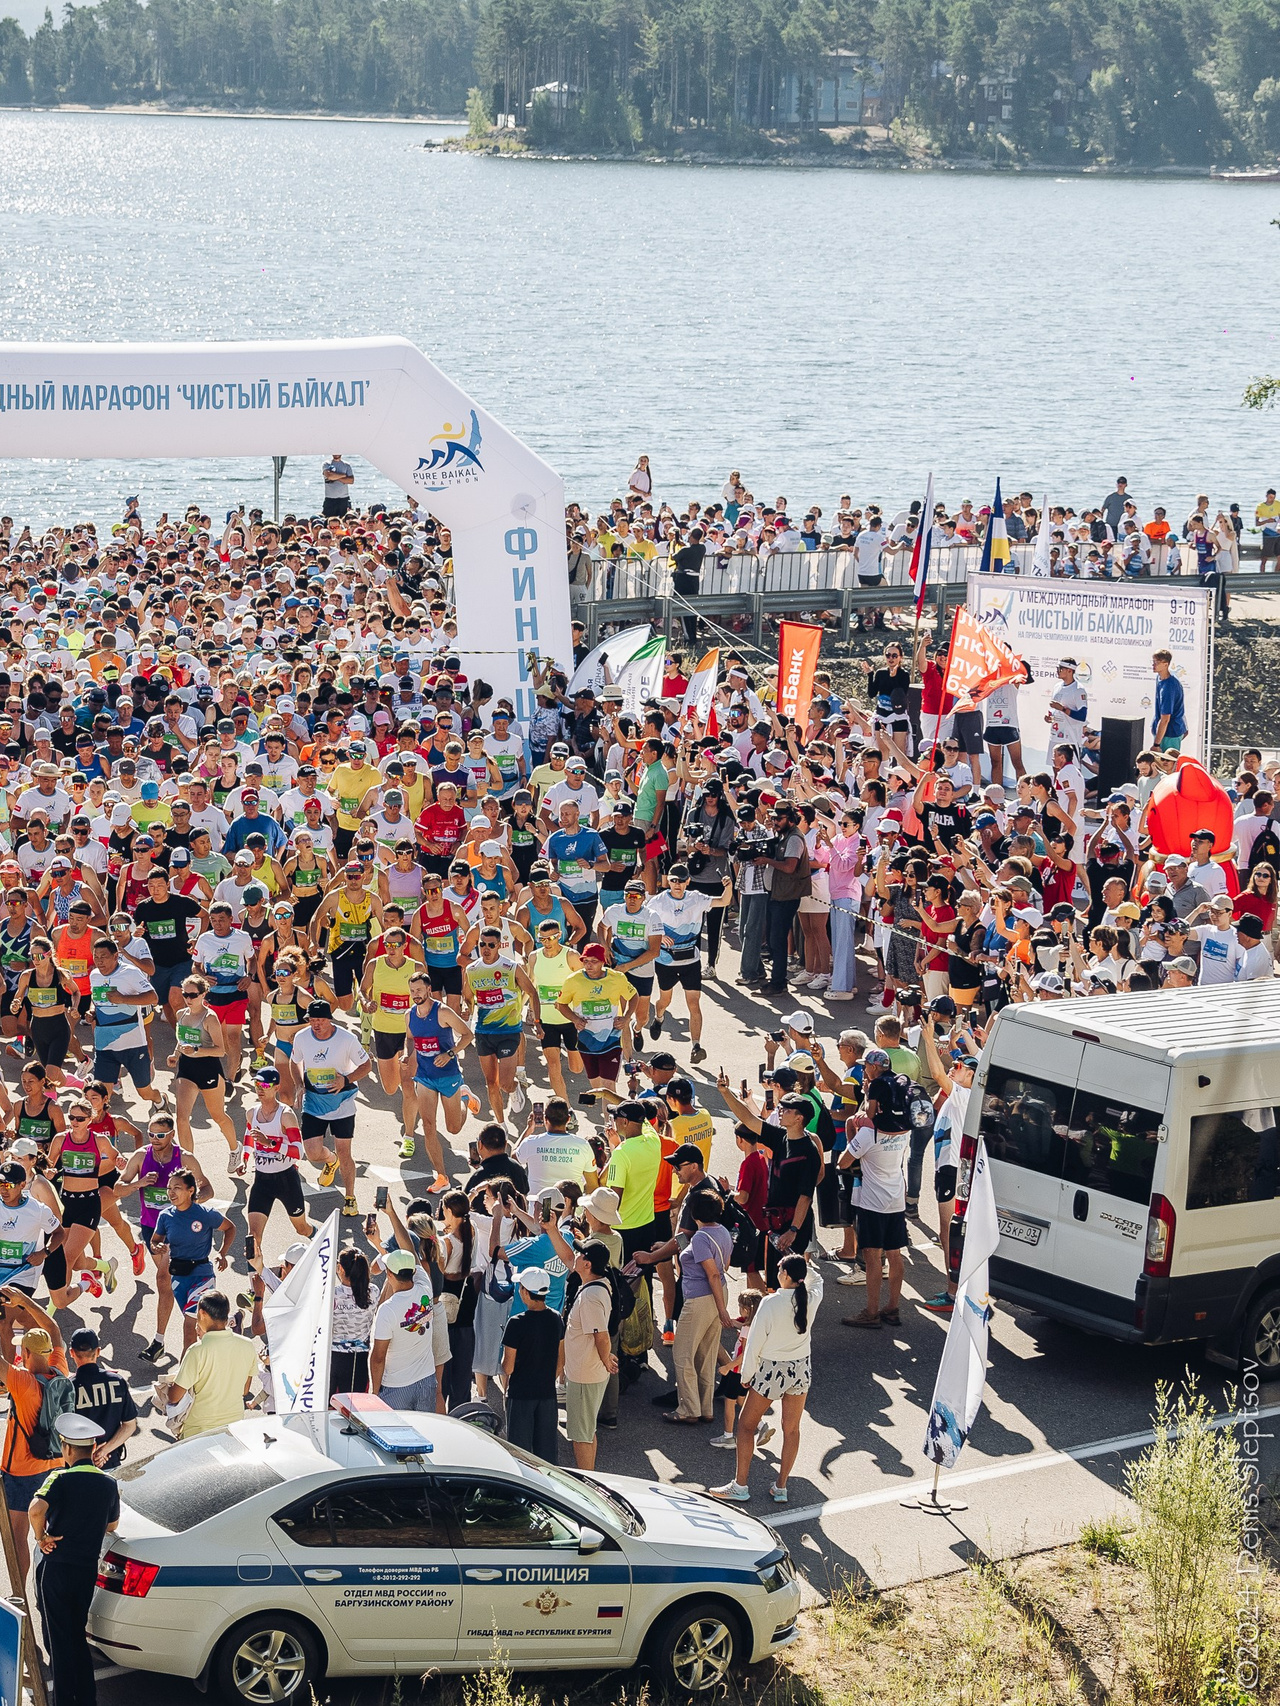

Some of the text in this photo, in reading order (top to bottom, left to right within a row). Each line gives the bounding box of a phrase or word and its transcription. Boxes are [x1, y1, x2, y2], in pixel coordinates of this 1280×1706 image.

[62, 383, 170, 412] МАРАФОН
[412, 468, 477, 481] PURE BAIKAL
[414, 476, 479, 486] MARATHON
[1019, 590, 1154, 612] V МЕЖДУНАРОДНЫЙ МАРАФОН
[1019, 608, 1153, 635] «ЧИСТЫЙ БАЙКАЛ»
[1170, 617, 1195, 626] АВГУСТА
[1090, 635, 1113, 645] НАТАЛЬИ
[1169, 629, 1195, 644] 2024
[425, 924, 452, 936] RUSSIA
[392, 999, 409, 1008] 231
[536, 1146, 580, 1157] BAIKALRUN.COM
[541, 1155, 573, 1164] 10.08.2024
[1026, 1228, 1036, 1239] 03
[74, 1380, 123, 1409] ДПС
[648, 1487, 749, 1540] ДПС
[505, 1568, 590, 1584] ПОЛИЦИЯ
[343, 1589, 373, 1598] ОТДЕЛ
[374, 1589, 395, 1598] МВД
[396, 1589, 434, 1597] РОССИИ
[334, 1598, 454, 1608] БАРГУЗИНСКОМУ РАЙОНУ
